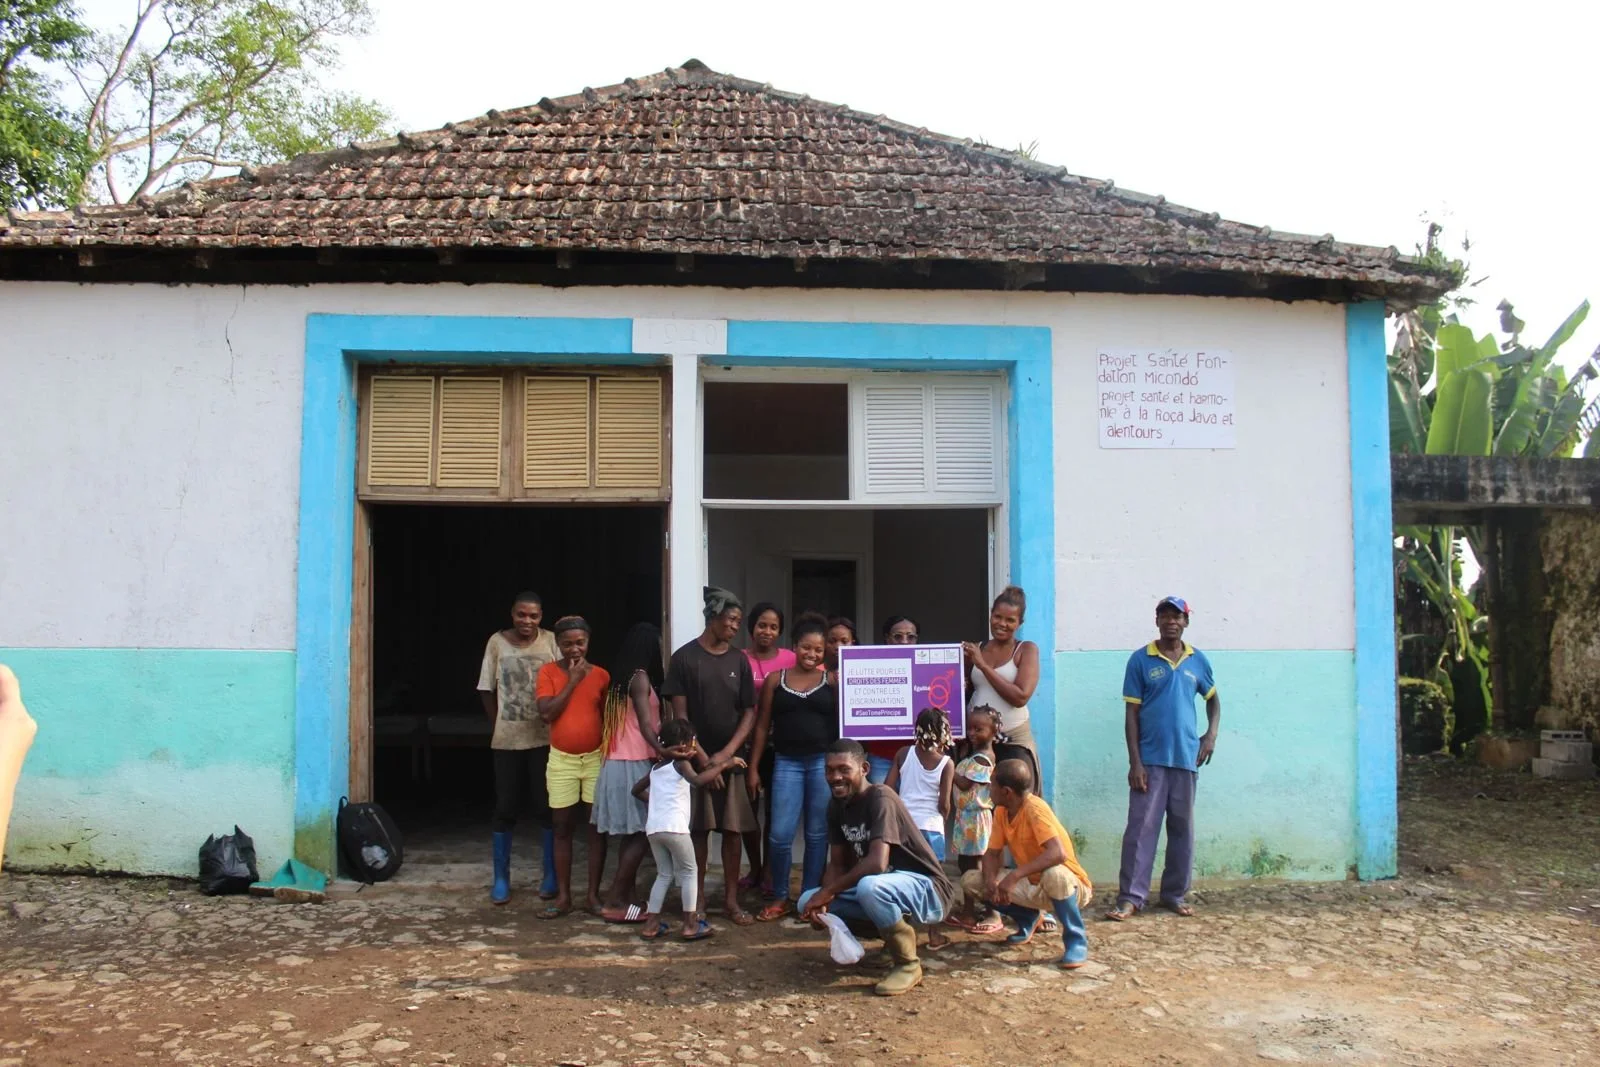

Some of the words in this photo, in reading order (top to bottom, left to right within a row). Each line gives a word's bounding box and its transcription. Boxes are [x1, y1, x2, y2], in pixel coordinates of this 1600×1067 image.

[1147, 352, 1188, 368] Santé
[1140, 391, 1170, 404] santé
[1173, 392, 1184, 404] et
[1139, 405, 1148, 421] la
[1155, 408, 1184, 425] Roça
[1188, 407, 1217, 425] Java
[1222, 413, 1234, 426] et
[1106, 424, 1163, 440] alentours
